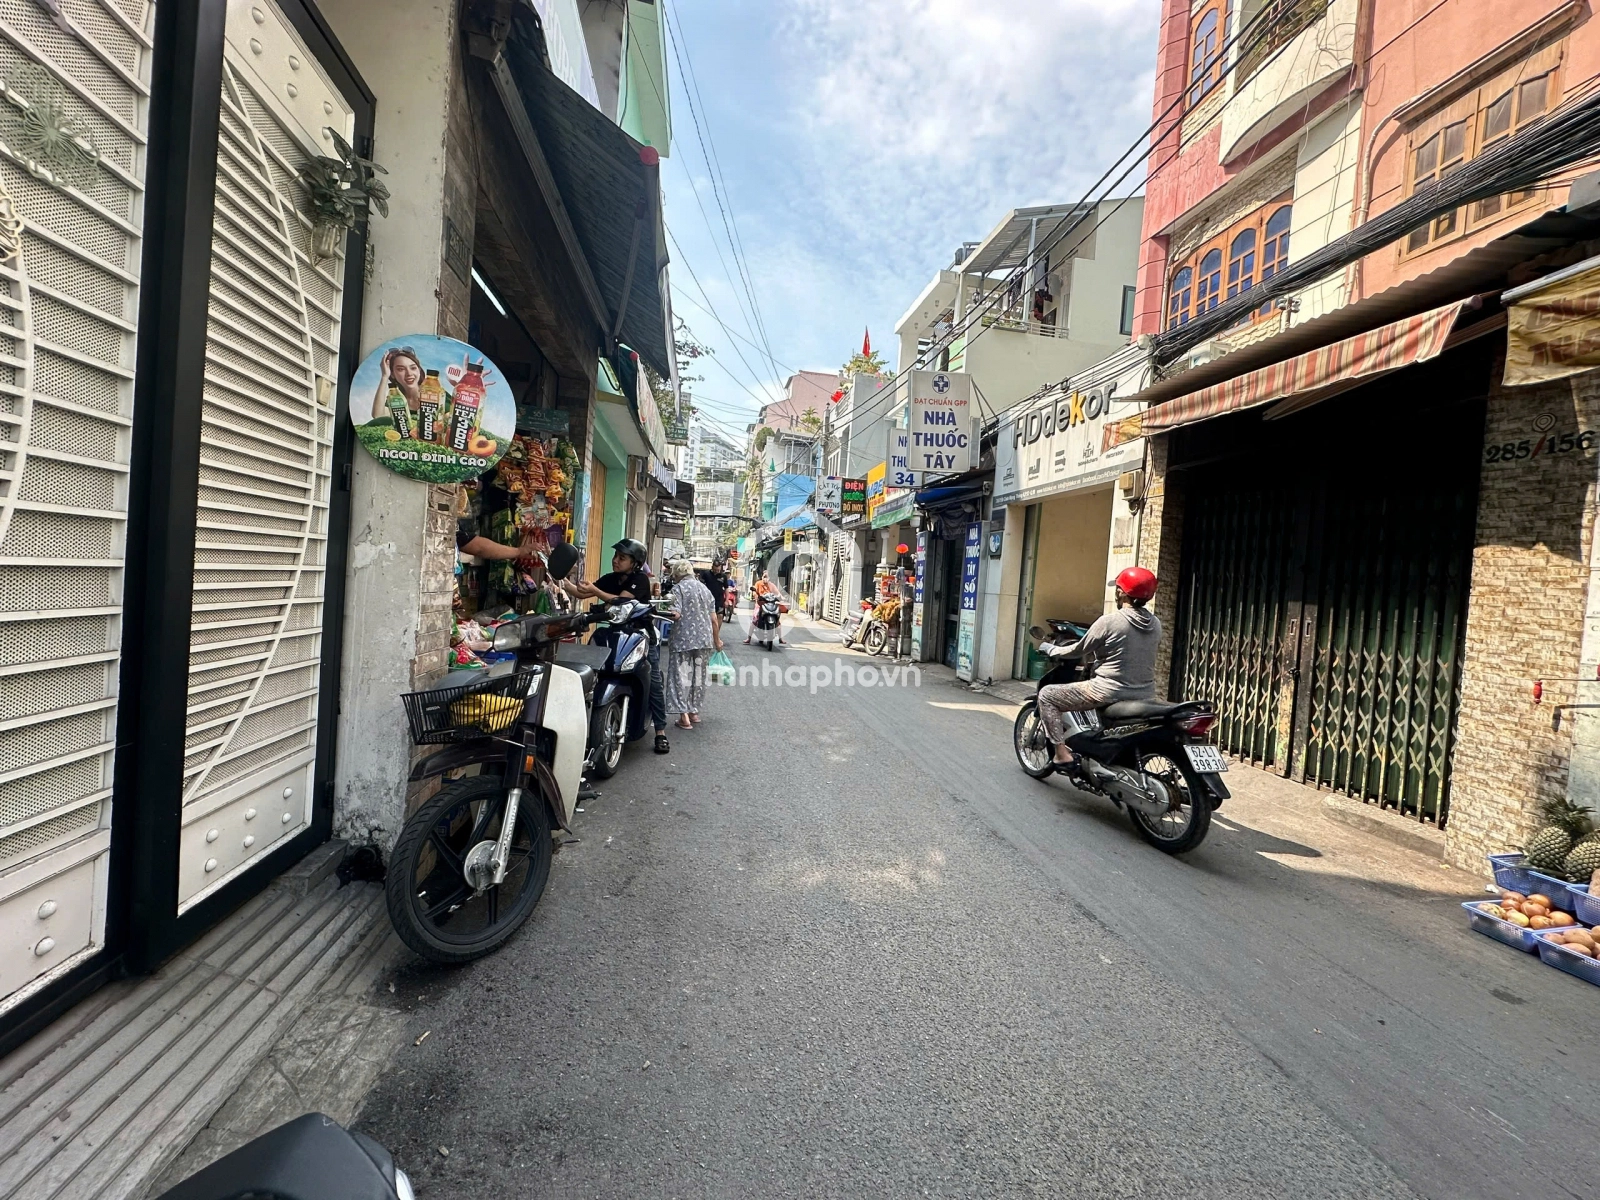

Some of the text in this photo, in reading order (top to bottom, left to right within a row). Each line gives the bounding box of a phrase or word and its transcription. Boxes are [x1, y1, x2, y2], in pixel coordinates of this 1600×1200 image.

[914, 397, 927, 405] ĐẠT
[455, 408, 475, 420] TEA
[923, 408, 957, 426] NHÀ
[1013, 382, 1118, 450] HDdekor
[424, 412, 433, 440] 365
[453, 416, 469, 450] 365
[912, 428, 968, 448] THUỐC
[1486, 430, 1595, 464] 285/156
[379, 448, 419, 461] NGON
[459, 455, 487, 468] CAO
[923, 451, 956, 469] TÂY
[845, 481, 864, 491] ĐIỆN
[895, 472, 915, 486] 34
[852, 504, 864, 512] INOX
[969, 525, 978, 540] NHÀ
[965, 541, 980, 558] THUỐC
[967, 561, 976, 576] TÂY
[915, 593, 922, 602] 34
[964, 597, 974, 608] 34
[1192, 759, 1226, 771] 398.30
